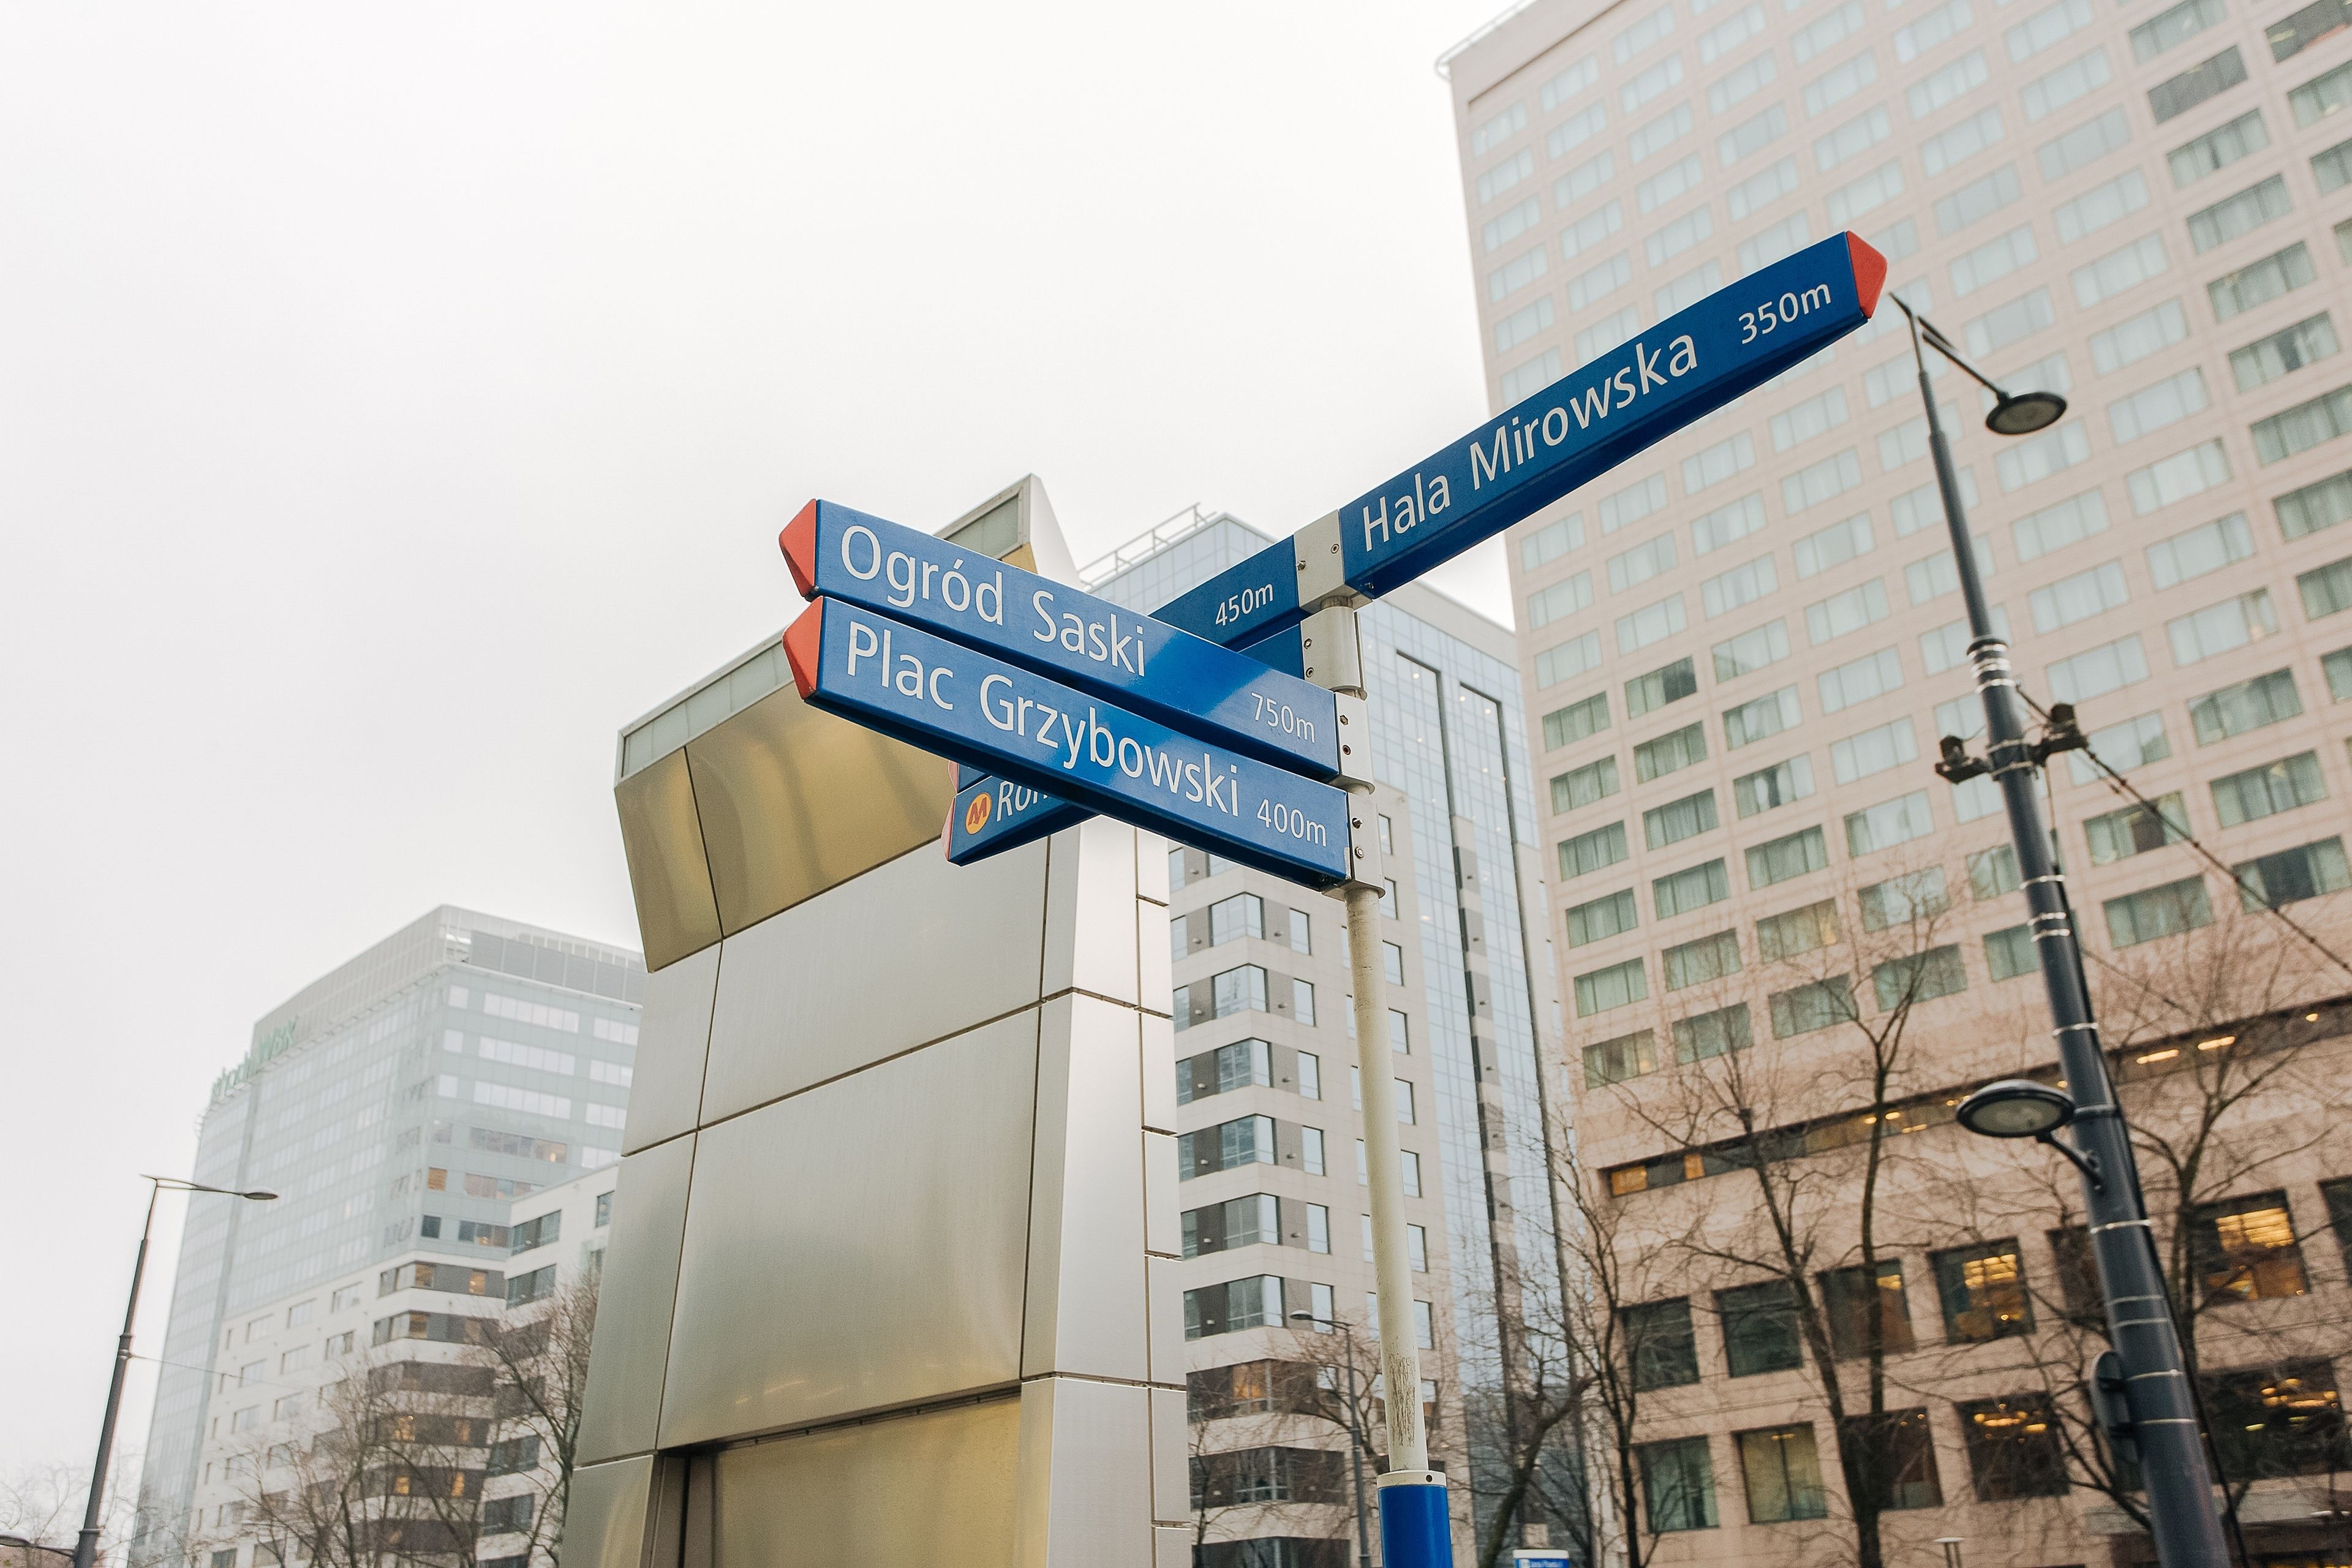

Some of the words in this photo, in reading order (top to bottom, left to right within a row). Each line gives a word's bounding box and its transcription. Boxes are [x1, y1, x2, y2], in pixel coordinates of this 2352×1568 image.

[1362, 472, 1451, 552] Hala
[1469, 334, 1698, 491] Mirowska
[1738, 284, 1831, 344] 350m
[840, 524, 1003, 627] Ogród
[1032, 589, 1145, 677] Saski
[1251, 692, 1316, 744] 750m
[1215, 583, 1274, 627] 450m
[846, 620, 954, 710] Plac
[979, 673, 1239, 817] Grzybowski
[1256, 798, 1327, 847] 400m
